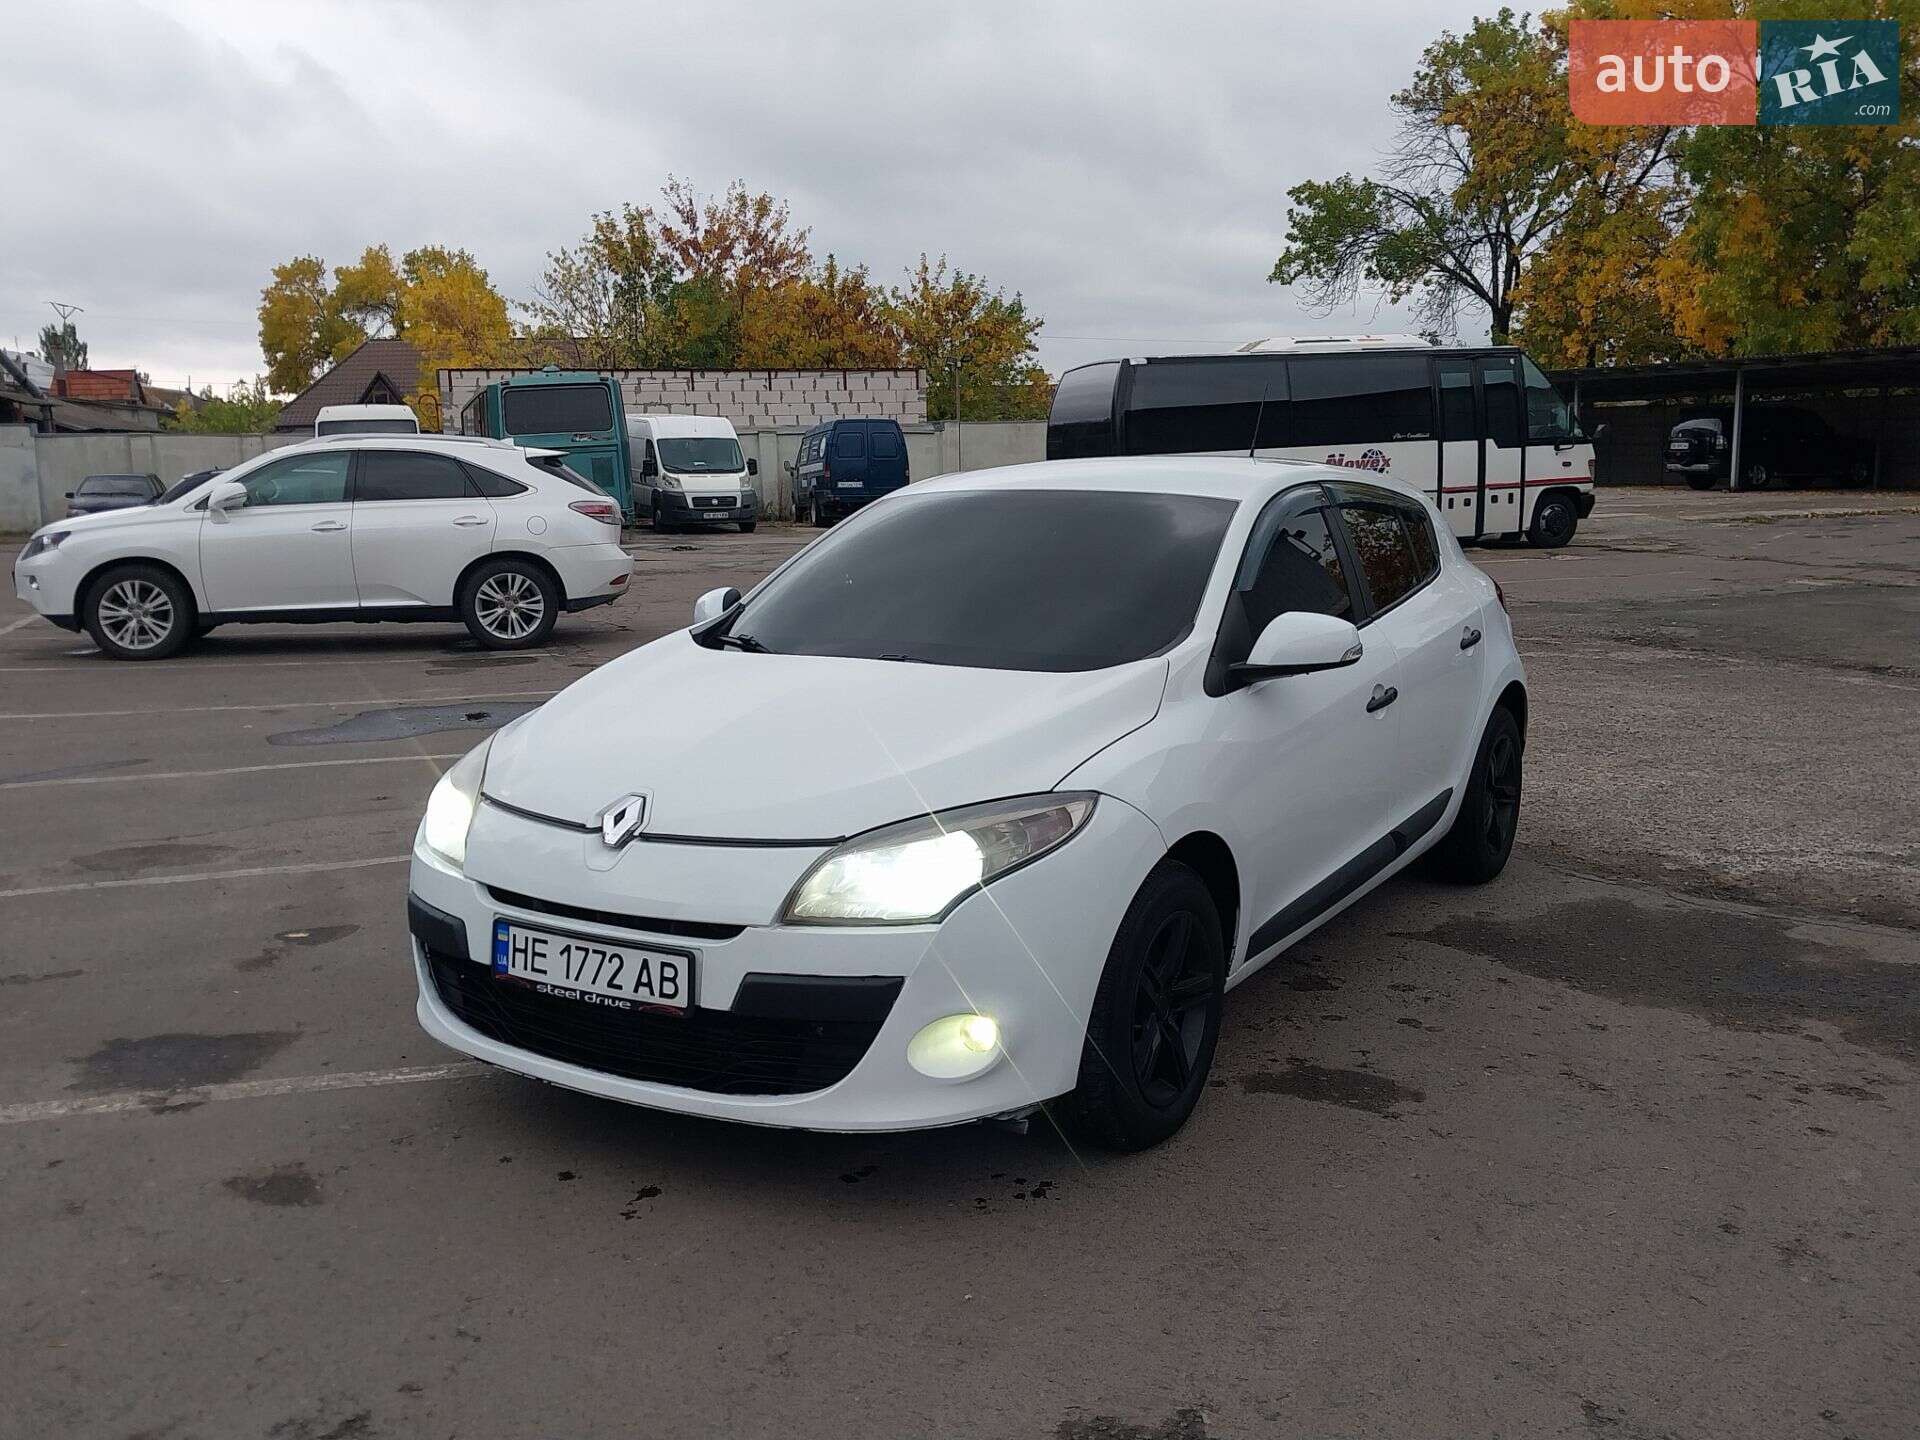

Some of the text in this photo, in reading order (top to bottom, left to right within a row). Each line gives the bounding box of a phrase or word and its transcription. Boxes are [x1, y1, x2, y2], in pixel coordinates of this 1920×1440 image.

[497, 953, 507, 966] UA
[511, 933, 679, 999] HE 1772 AB
[536, 983, 632, 1010] steel drive
